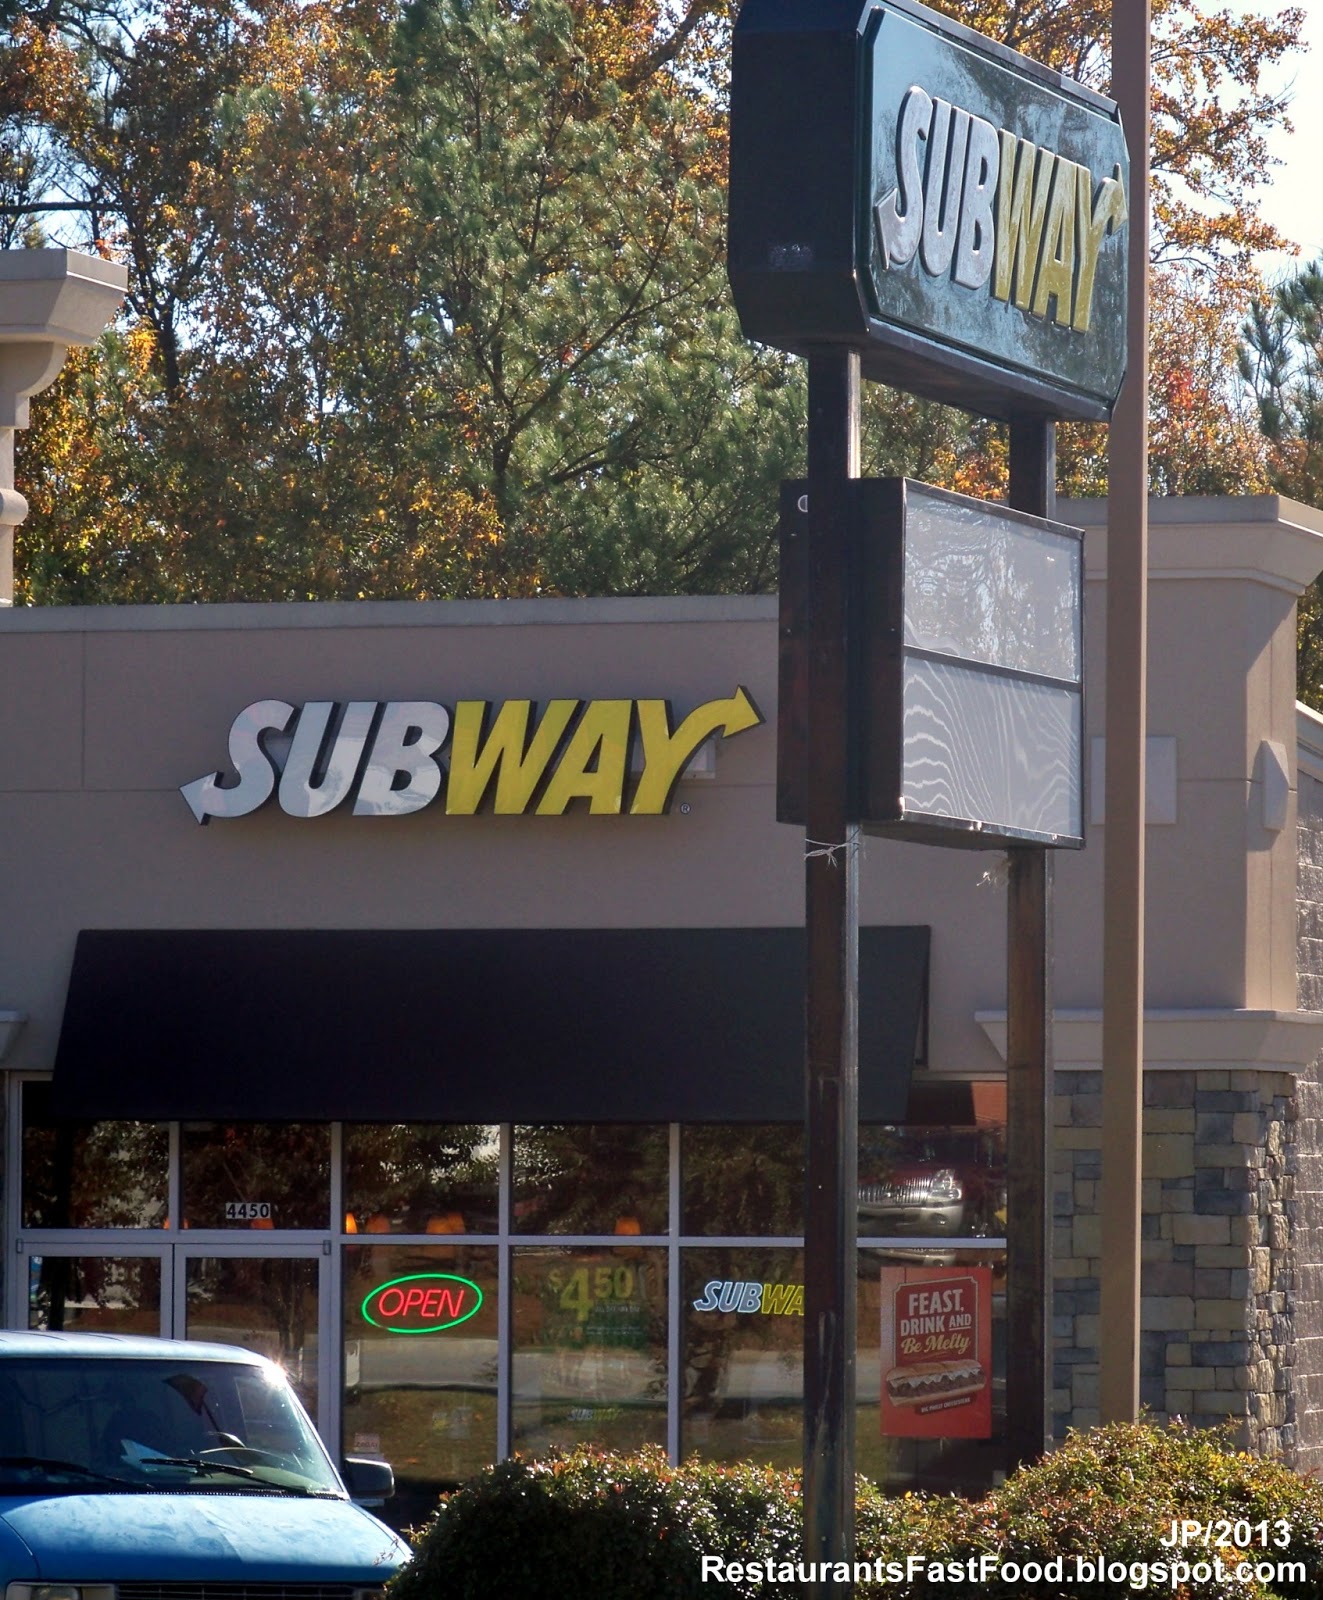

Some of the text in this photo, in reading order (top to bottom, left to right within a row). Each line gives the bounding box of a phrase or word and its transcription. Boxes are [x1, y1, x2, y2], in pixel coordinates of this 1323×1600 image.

[875, 84, 1128, 334] SUBWAY
[179, 684, 764, 825] SUBWAY
[227, 1204, 270, 1218] 4450
[379, 1288, 465, 1317] OPEN
[693, 1280, 804, 1316] SUBWA
[909, 1289, 964, 1315] FEAST,
[900, 1313, 972, 1336] DRINK AND
[901, 1333, 970, 1354] Be Melty
